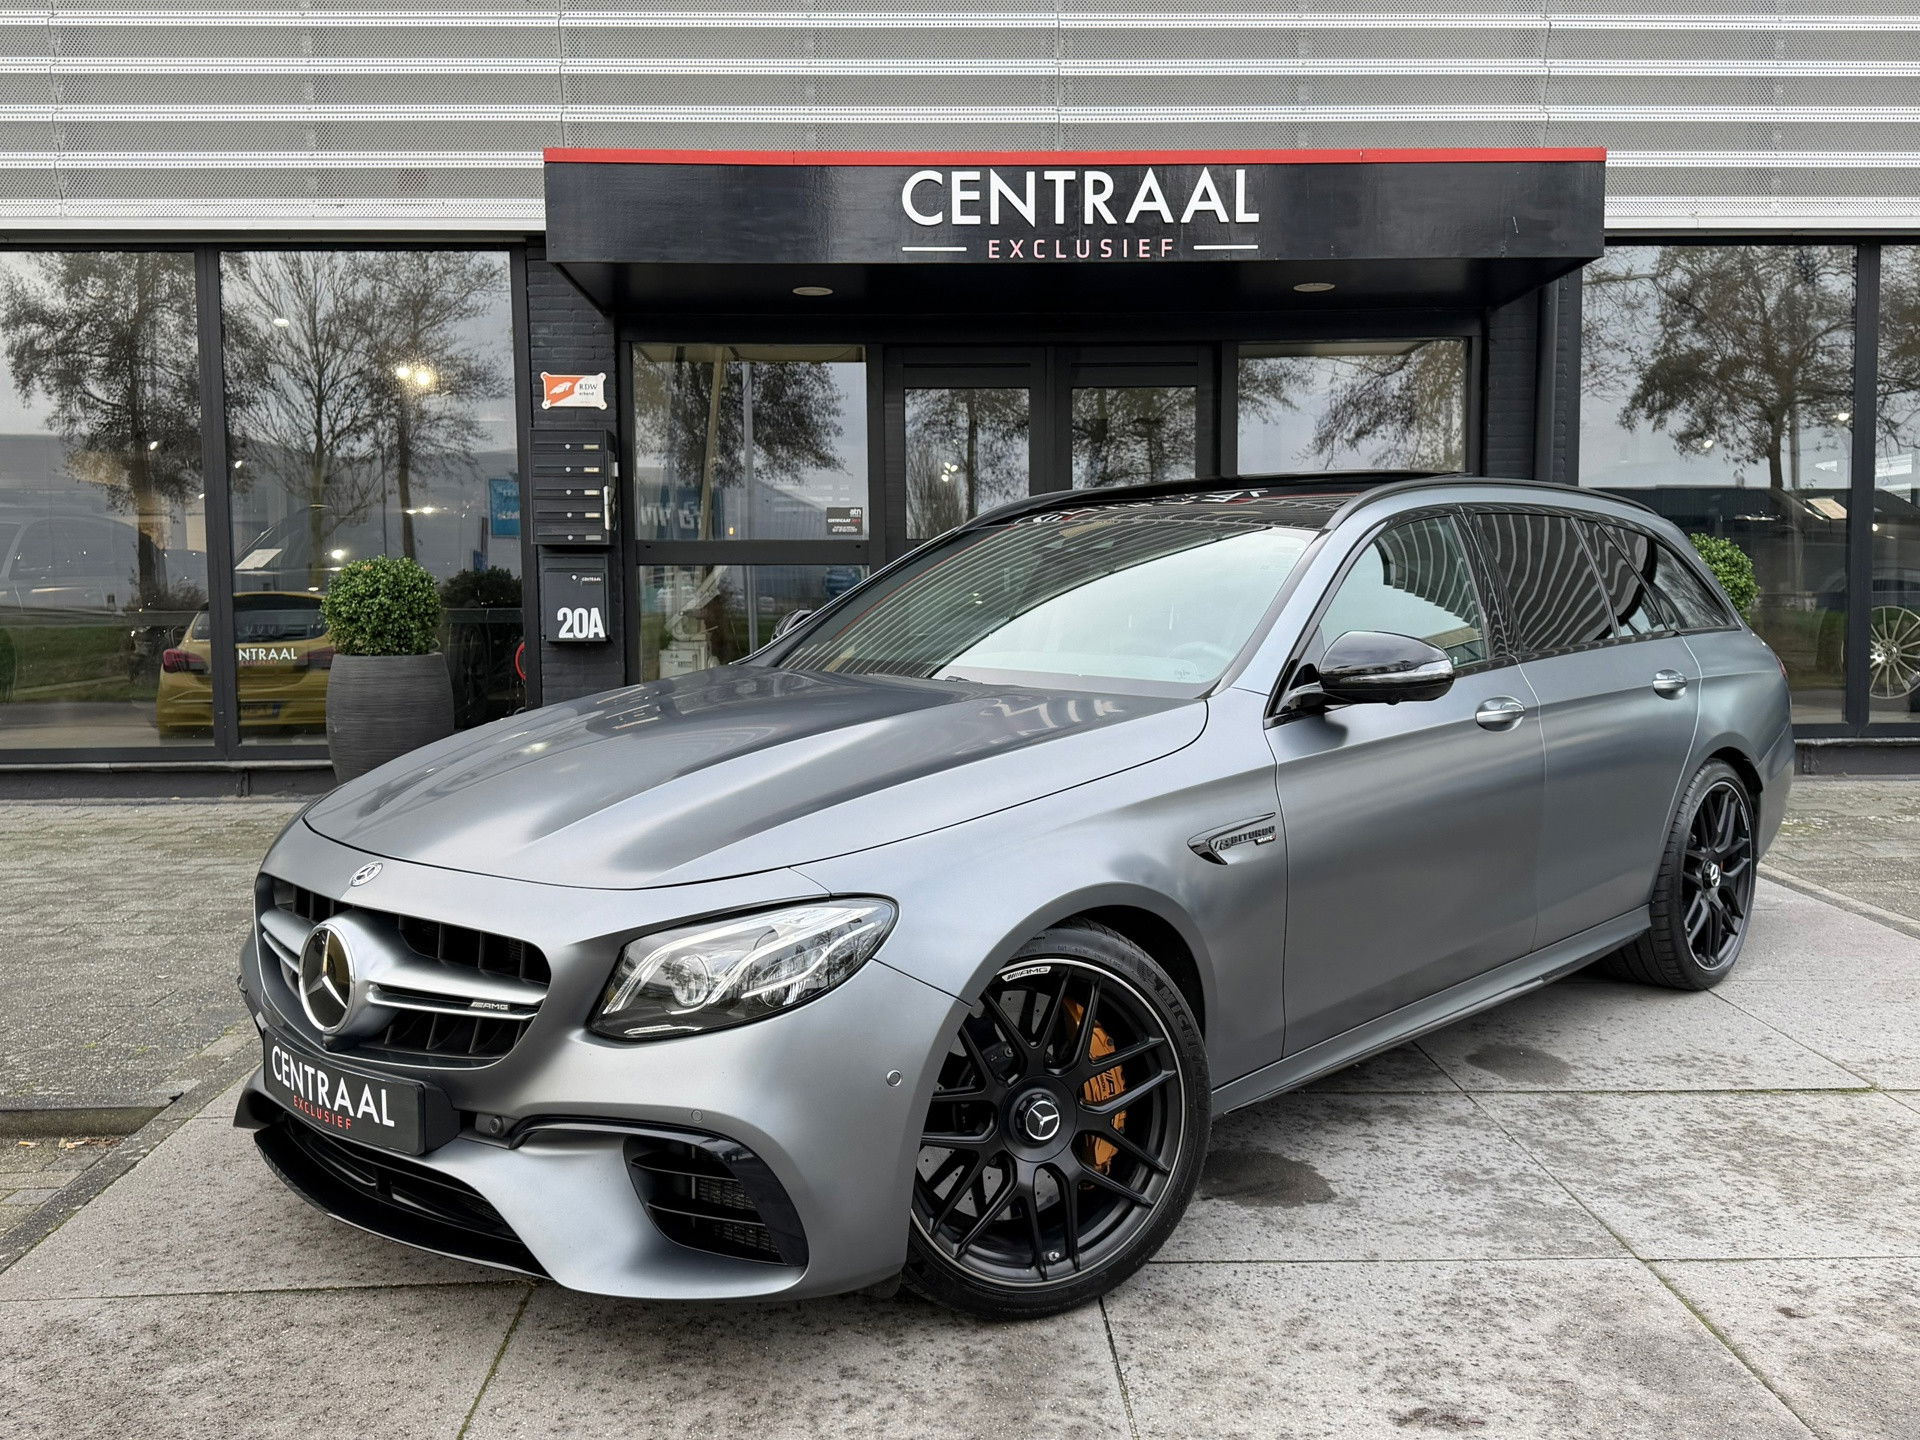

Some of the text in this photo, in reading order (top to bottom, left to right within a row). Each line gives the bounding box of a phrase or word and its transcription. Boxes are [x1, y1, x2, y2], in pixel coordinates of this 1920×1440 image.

[901, 167, 1260, 227] CENTRAAL
[988, 238, 1174, 260] EXCLUSIEF
[557, 607, 606, 638] 20A
[238, 648, 297, 661] NTRAAL
[1230, 825, 1276, 845] BITURBO
[272, 1045, 395, 1127] CENTRAAL
[293, 1095, 352, 1130] EXCLUSIEF
